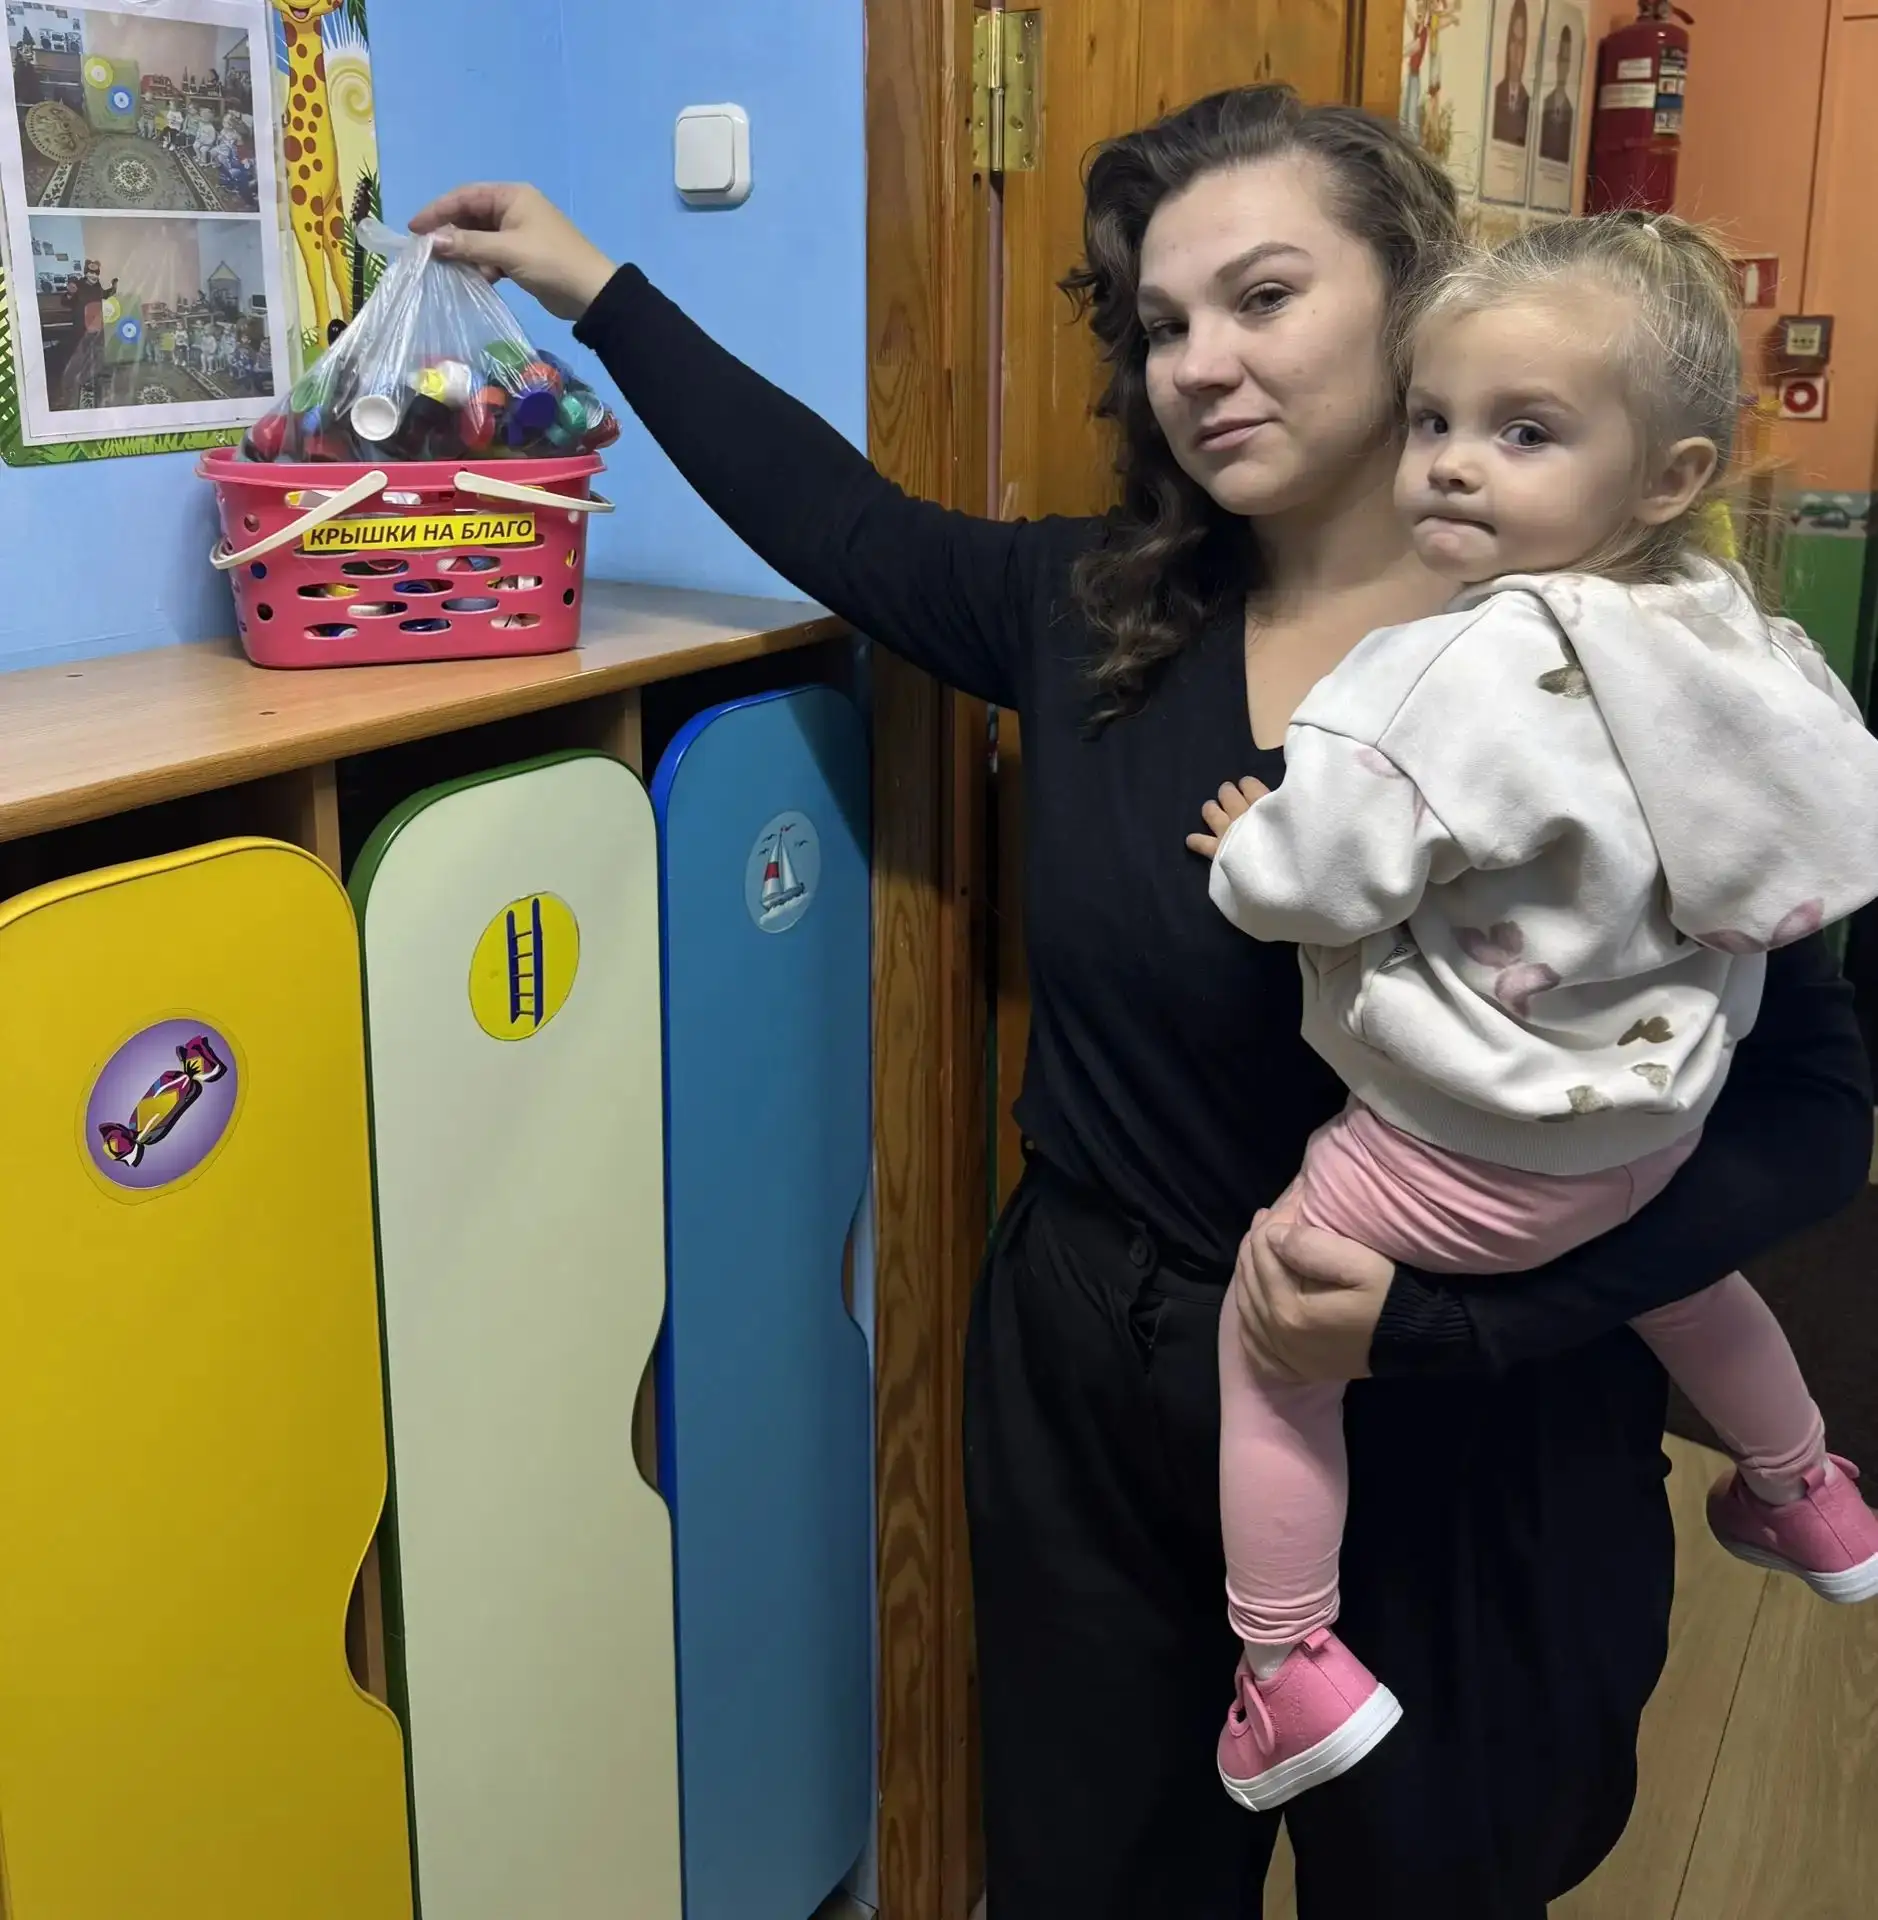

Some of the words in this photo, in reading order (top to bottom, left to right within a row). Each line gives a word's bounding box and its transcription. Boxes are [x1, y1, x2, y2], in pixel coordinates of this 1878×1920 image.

[310, 524, 416, 545] КРЫШКИ
[423, 524, 454, 541] НА
[461, 519, 533, 540] БЛАГО
